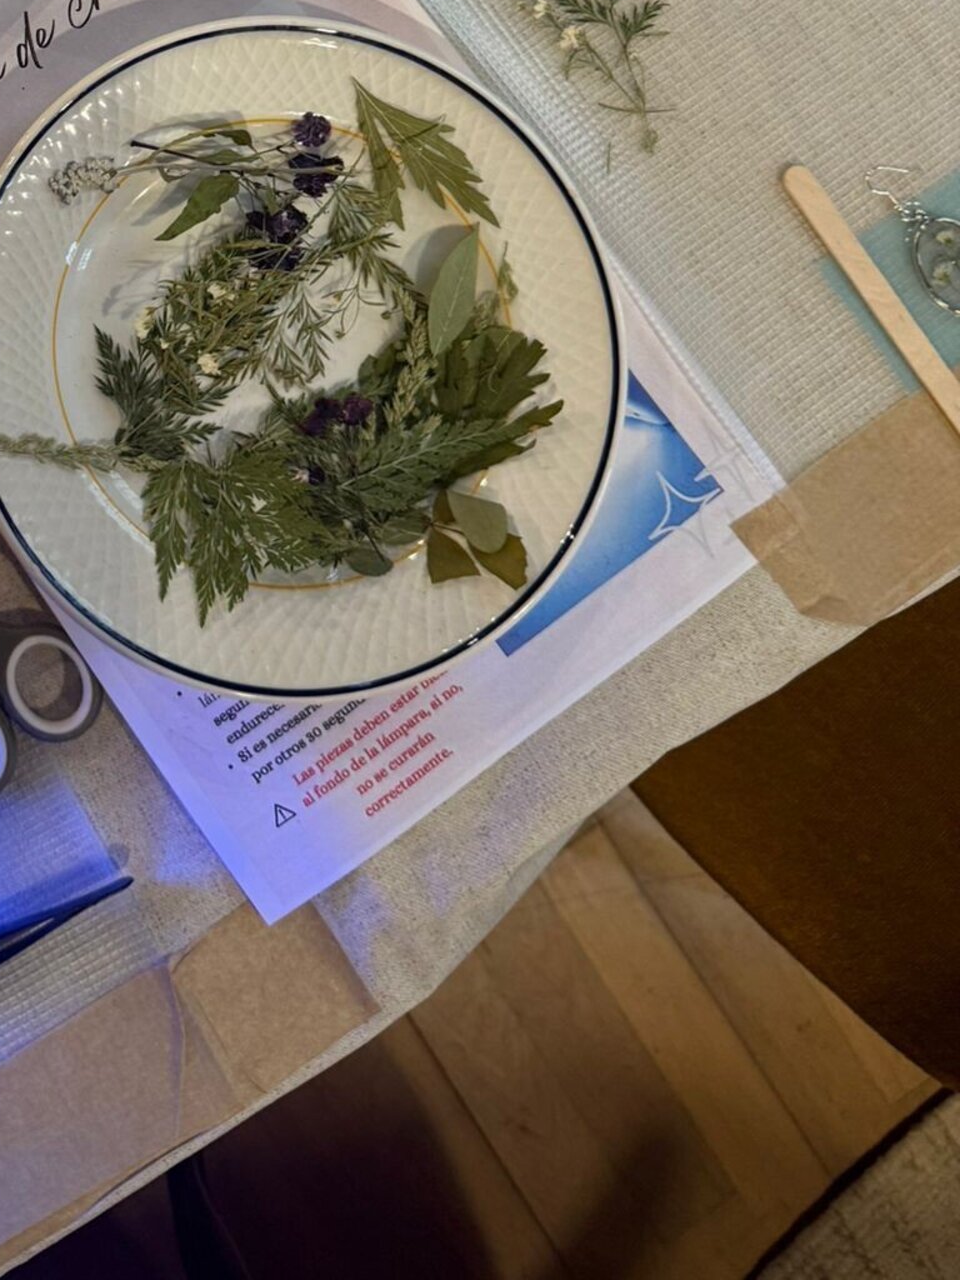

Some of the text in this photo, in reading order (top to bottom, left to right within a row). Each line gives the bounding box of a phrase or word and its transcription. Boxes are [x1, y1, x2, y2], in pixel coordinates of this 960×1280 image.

[16, 11, 54, 70] de
[236, 745, 254, 763] Si
[251, 738, 268, 754] es
[250, 760, 274, 785] por
[273, 737, 308, 766] otros
[304, 725, 323, 744] 30
[291, 685, 420, 786] Las piezas deben estar
[301, 683, 464, 808] al fondo de la lámpara, si no,
[355, 731, 436, 796] no se curarán
[364, 747, 454, 818] correctamente.
